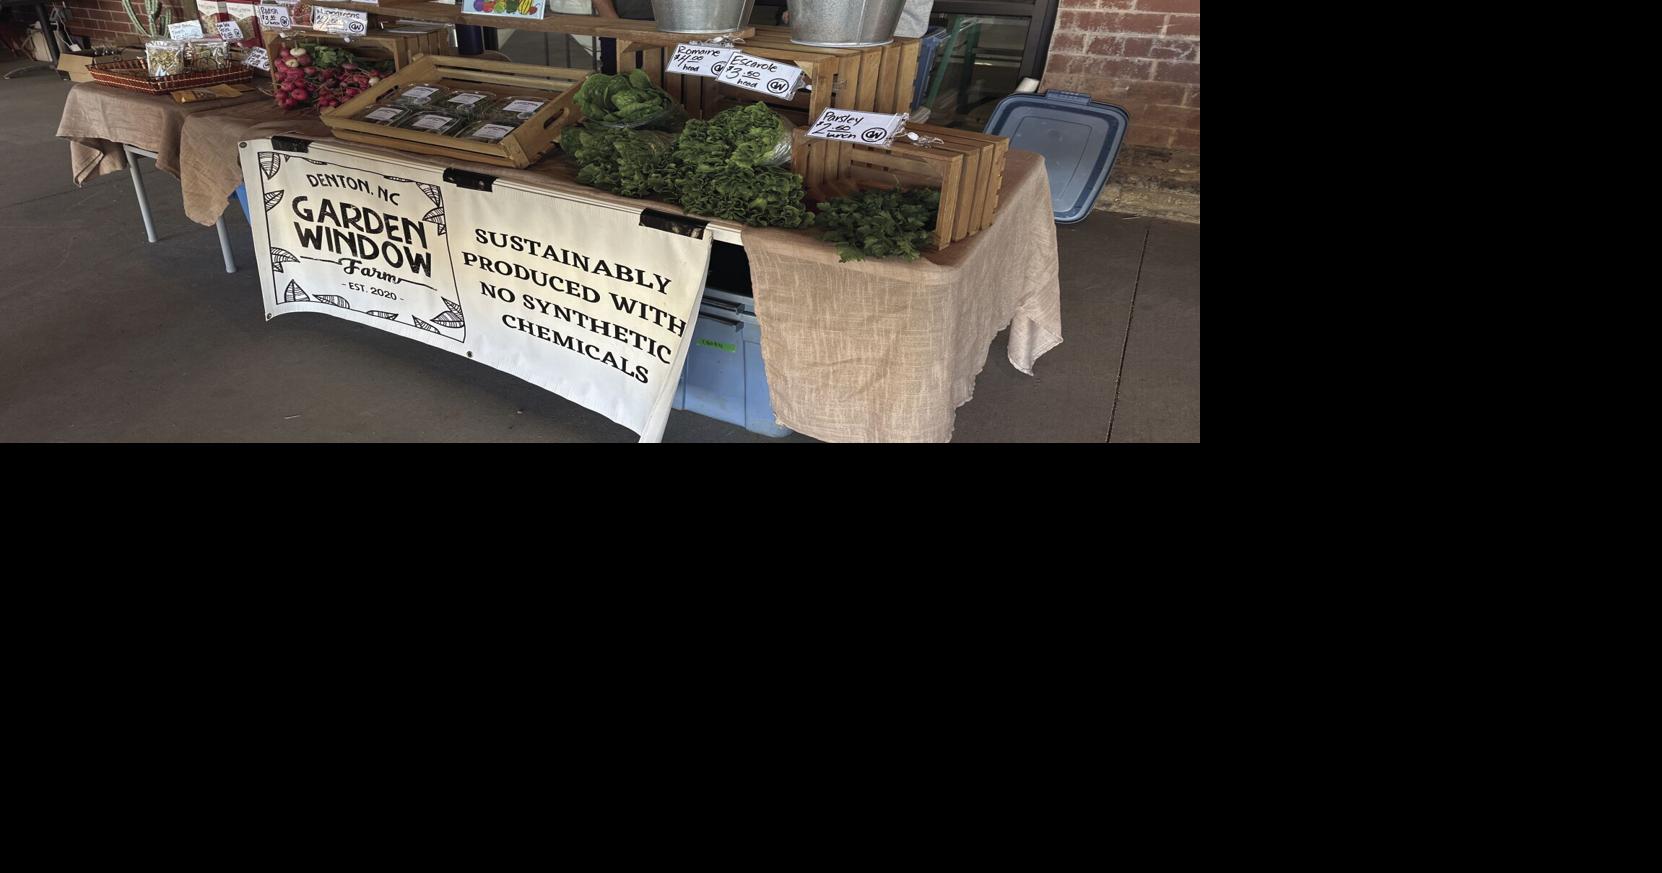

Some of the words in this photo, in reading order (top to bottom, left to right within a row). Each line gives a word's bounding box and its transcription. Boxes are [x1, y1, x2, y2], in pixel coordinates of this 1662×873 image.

[678, 45, 720, 57] Romaine
[730, 55, 777, 73] Escarole
[737, 78, 758, 89] head
[823, 111, 864, 126] Parsley
[378, 186, 400, 206] NC
[292, 196, 428, 249] GARDEN
[294, 222, 432, 278] WINDOW
[475, 228, 672, 295] SUSTAINABLY
[339, 258, 401, 284] Farm
[349, 282, 368, 293] EST.
[370, 287, 397, 300] 2020
[462, 251, 601, 303] PRODUCED
[609, 292, 687, 338] WITH
[480, 281, 516, 303] NO
[522, 294, 672, 365] SYNTHETIC
[501, 314, 649, 384] CHEMICALS
